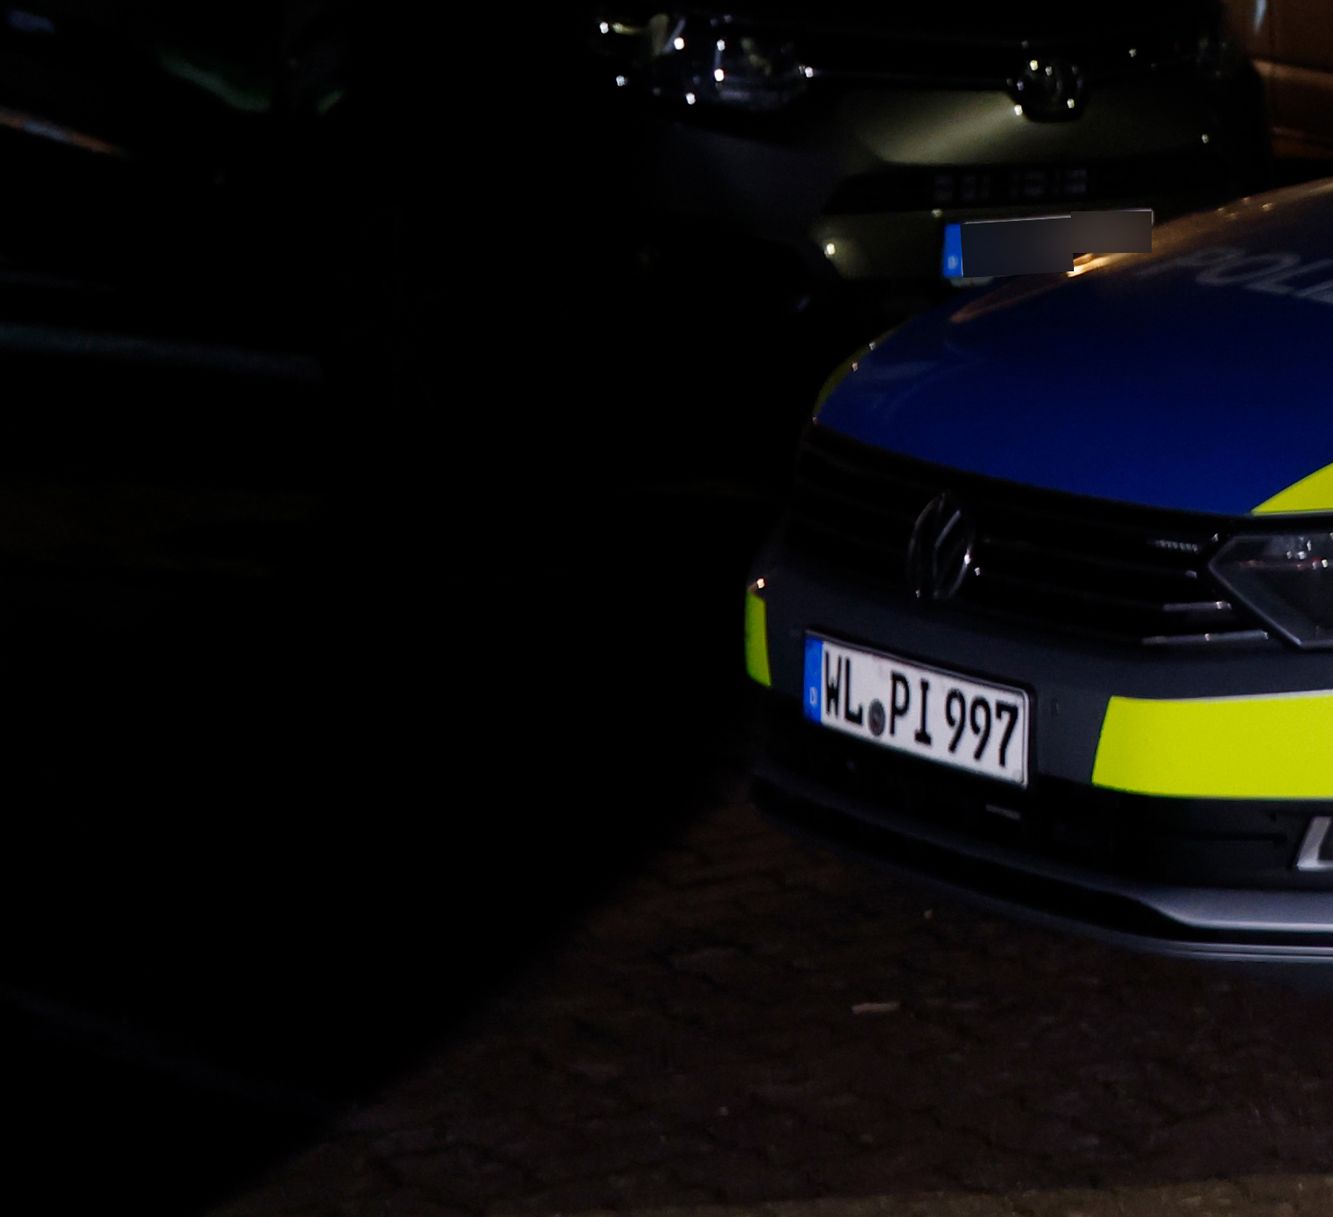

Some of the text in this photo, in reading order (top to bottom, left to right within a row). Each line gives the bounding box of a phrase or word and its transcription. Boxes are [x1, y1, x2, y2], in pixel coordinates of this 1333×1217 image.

[824, 650, 1018, 768] WL PI 997
